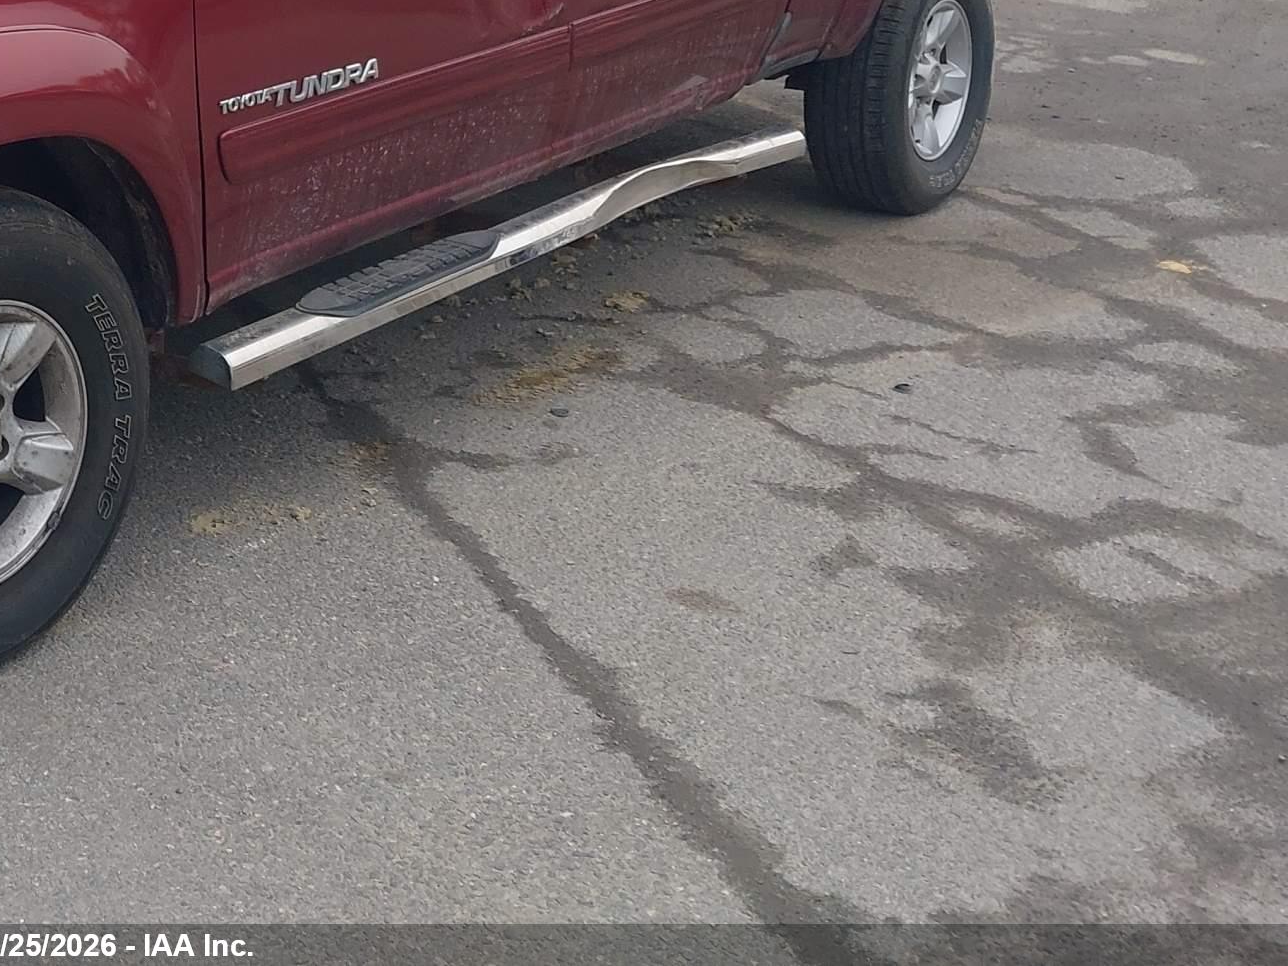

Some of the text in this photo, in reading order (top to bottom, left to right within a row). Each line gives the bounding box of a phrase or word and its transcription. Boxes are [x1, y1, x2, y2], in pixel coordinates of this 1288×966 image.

[219, 57, 380, 115] TOYOTA TUNDRA
[85, 293, 133, 521] TERRA TRAC
